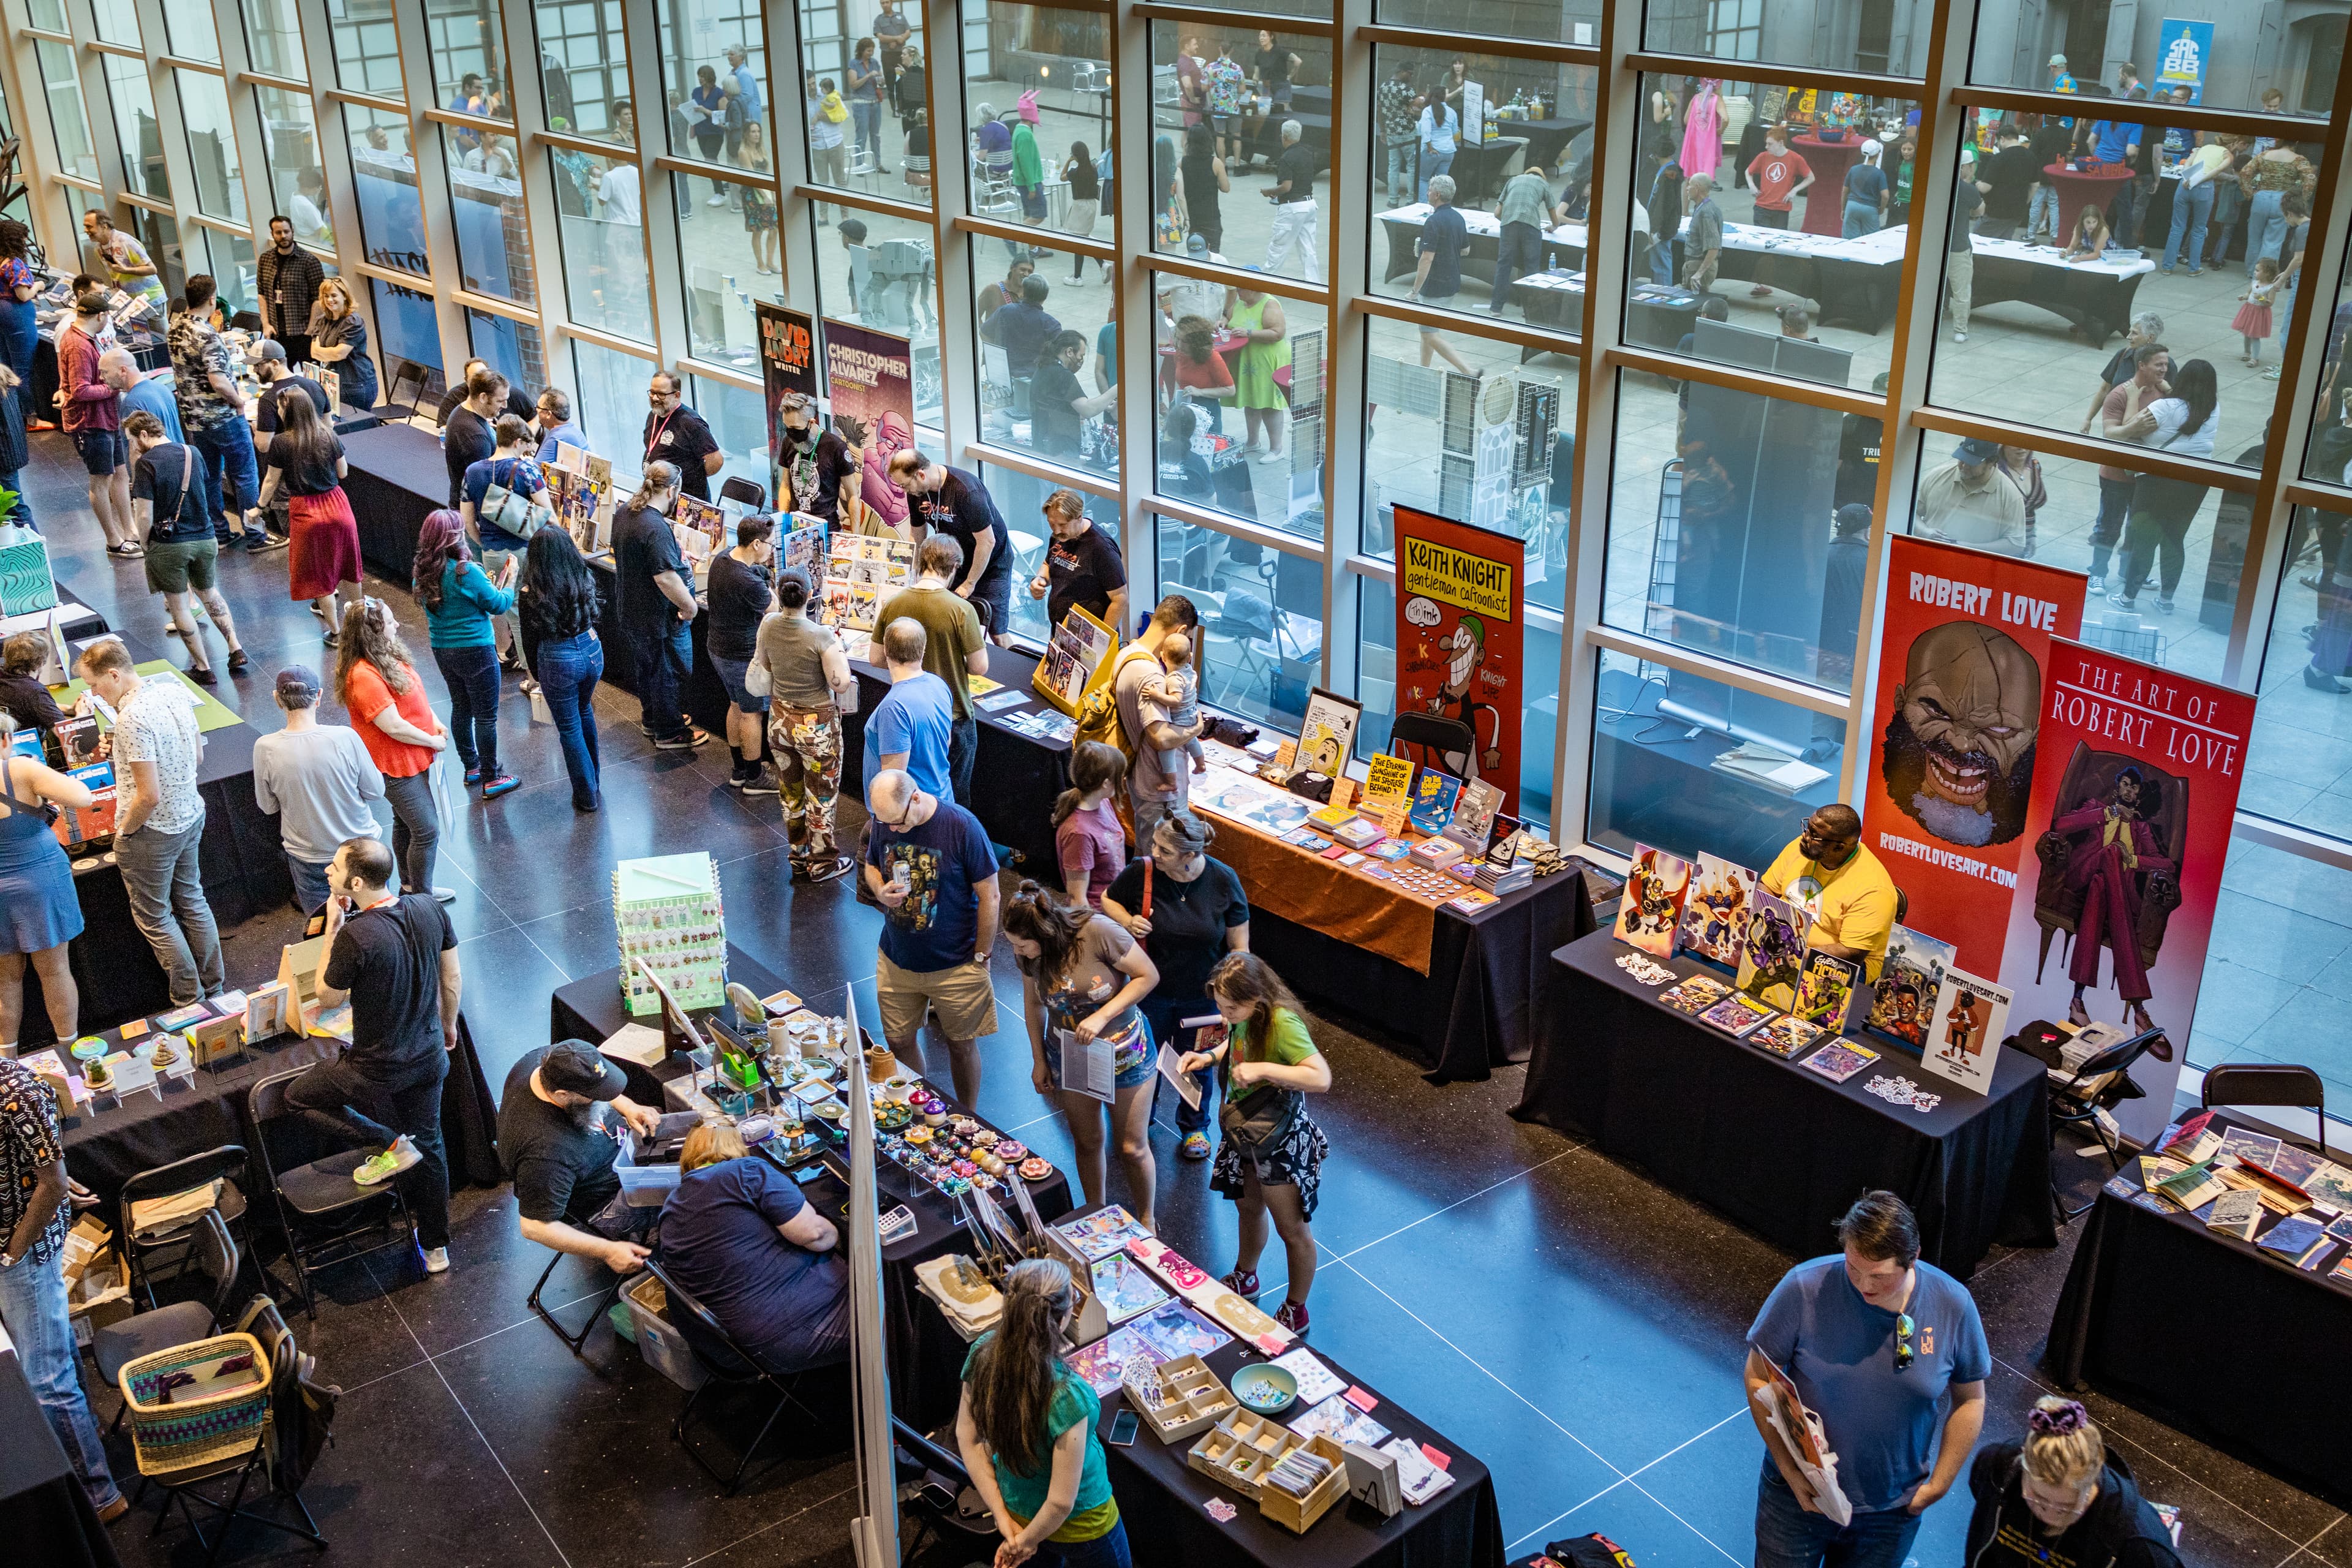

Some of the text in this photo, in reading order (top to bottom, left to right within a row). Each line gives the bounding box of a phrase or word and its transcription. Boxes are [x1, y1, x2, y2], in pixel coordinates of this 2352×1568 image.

[2169, 39, 2199, 59] SAC
[2163, 58, 2199, 74] BB
[761, 317, 810, 349] DAVID
[764, 338, 810, 368] ANDRY
[828, 342, 908, 379] CHRISTOPHER
[774, 361, 801, 375] WRITER
[830, 360, 879, 386] ALVAREZ
[830, 377, 865, 393] CARTOONIST
[1408, 571, 1457, 597] gentleman
[1452, 554, 1506, 592] KNIGHT
[1909, 571, 2059, 631] ROBERT LOVE
[1418, 643, 1430, 659] K
[1480, 668, 1508, 687] KNIGHT
[2079, 661, 2217, 723] THE ART OF
[2051, 690, 2237, 777] ROBERT LOVE
[1374, 757, 1408, 772] THE ETERNAL
[1370, 774, 1405, 789] THE SPOTLESS
[1421, 782, 1442, 790] KNIGHT
[1879, 832, 2018, 889] ROBERTLOVESART.COM
[1946, 973, 2009, 1006] ROBERTLOVESART.COM
